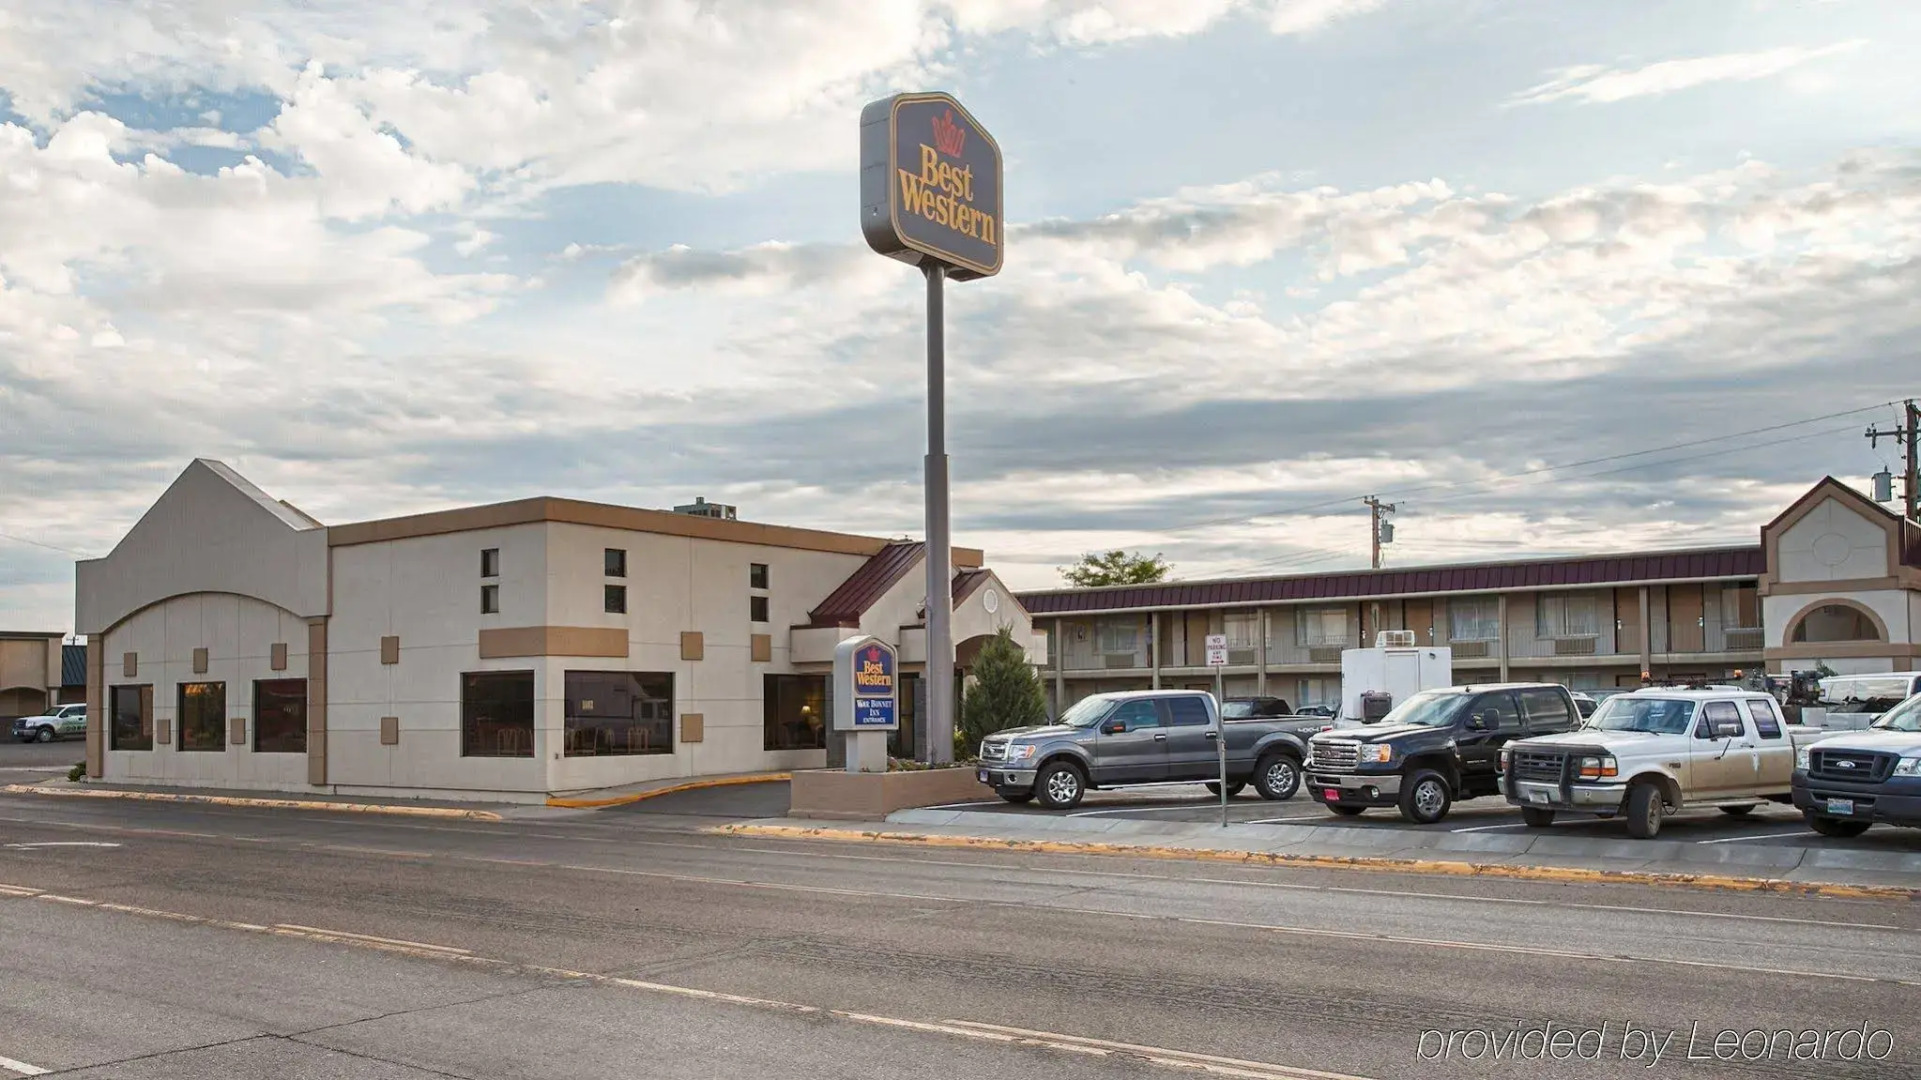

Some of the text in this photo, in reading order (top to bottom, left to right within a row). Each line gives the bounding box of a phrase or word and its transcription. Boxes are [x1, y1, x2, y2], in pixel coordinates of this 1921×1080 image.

[919, 143, 973, 202] Best
[898, 168, 996, 245] Western
[857, 671, 892, 686] Western
[864, 660, 883, 674] Best
